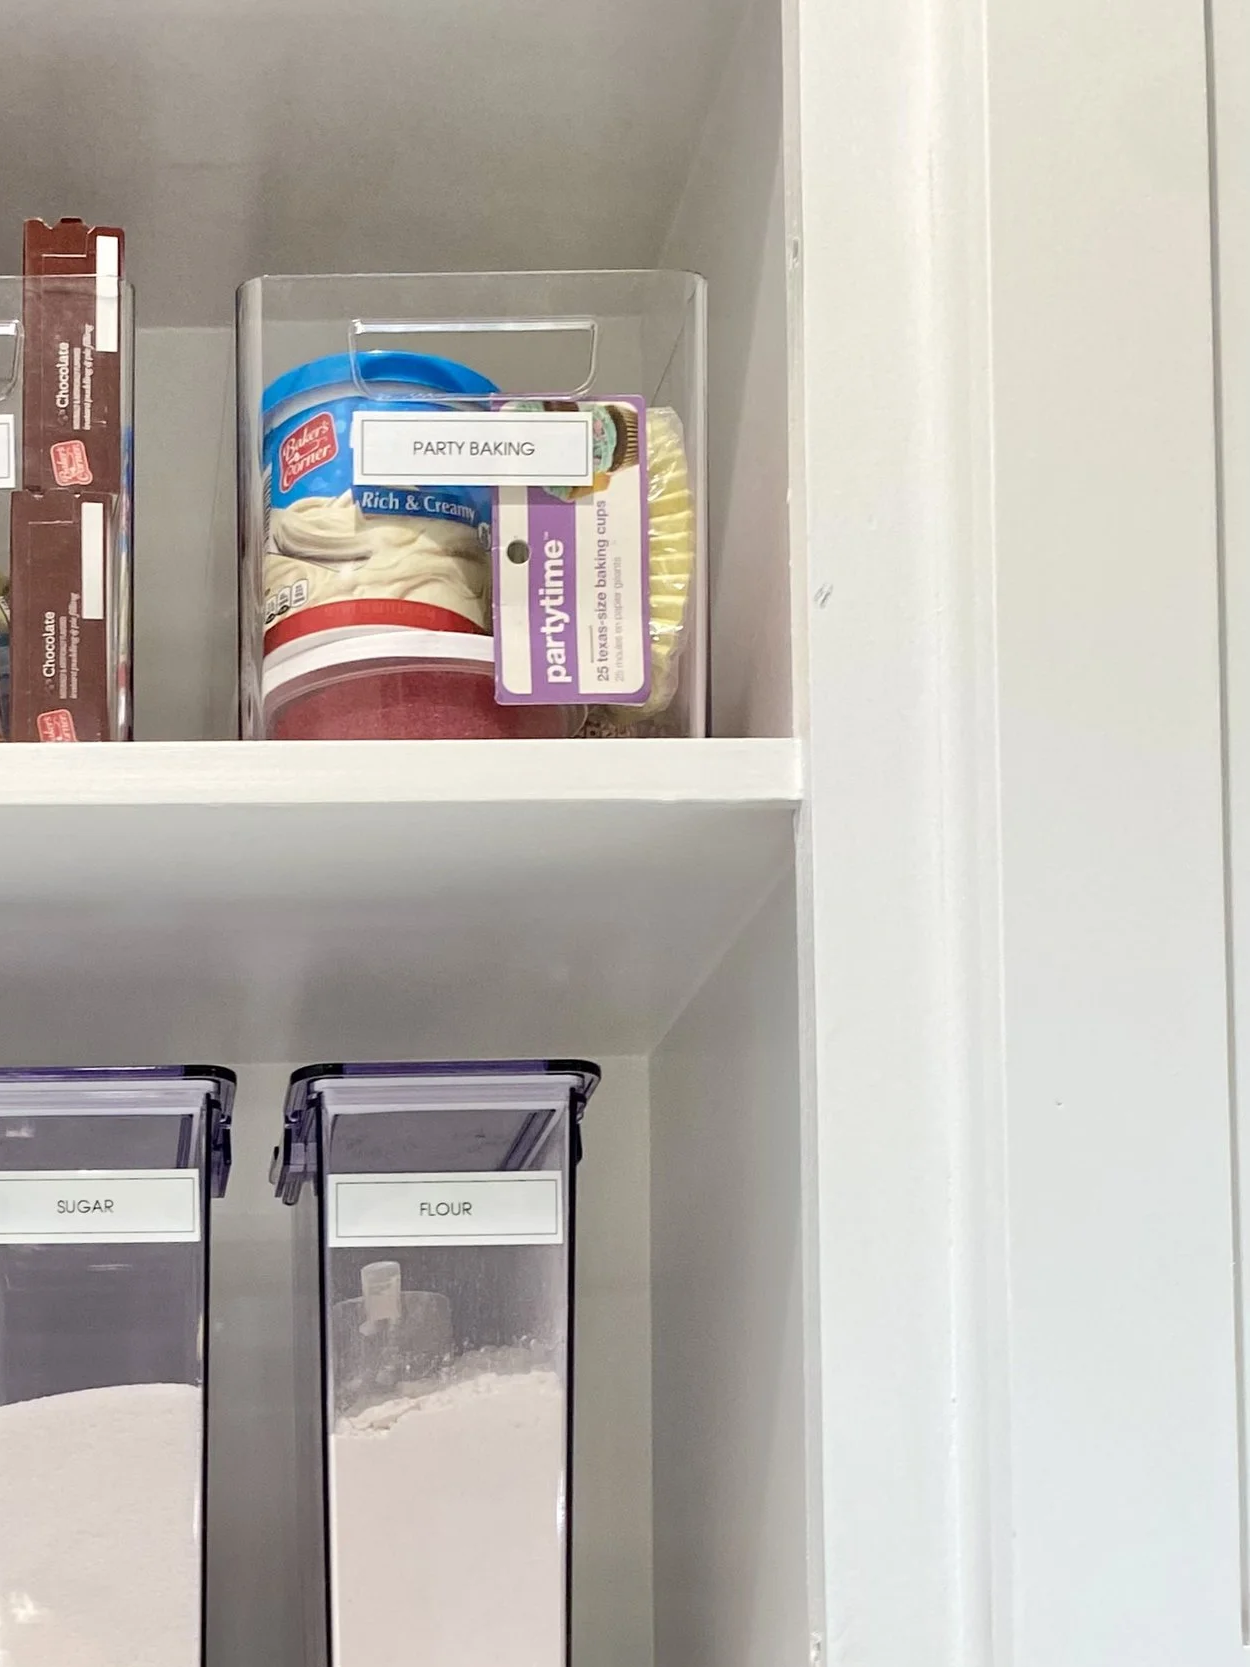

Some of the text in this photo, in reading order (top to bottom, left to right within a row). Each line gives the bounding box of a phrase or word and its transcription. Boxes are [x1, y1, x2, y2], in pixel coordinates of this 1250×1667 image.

[55, 342, 69, 408] Chocolate
[283, 420, 329, 462] Baker's
[413, 441, 535, 456] PARTY BAKING
[284, 445, 331, 487] Corner
[362, 491, 476, 522] Rich & Creamy
[538, 540, 573, 683] partytime
[594, 500, 609, 682] 25 texas-size baking cups
[42, 611, 56, 678] Chocolate
[57, 1199, 114, 1214] SUGAR
[419, 1202, 472, 1217] FLOUR
